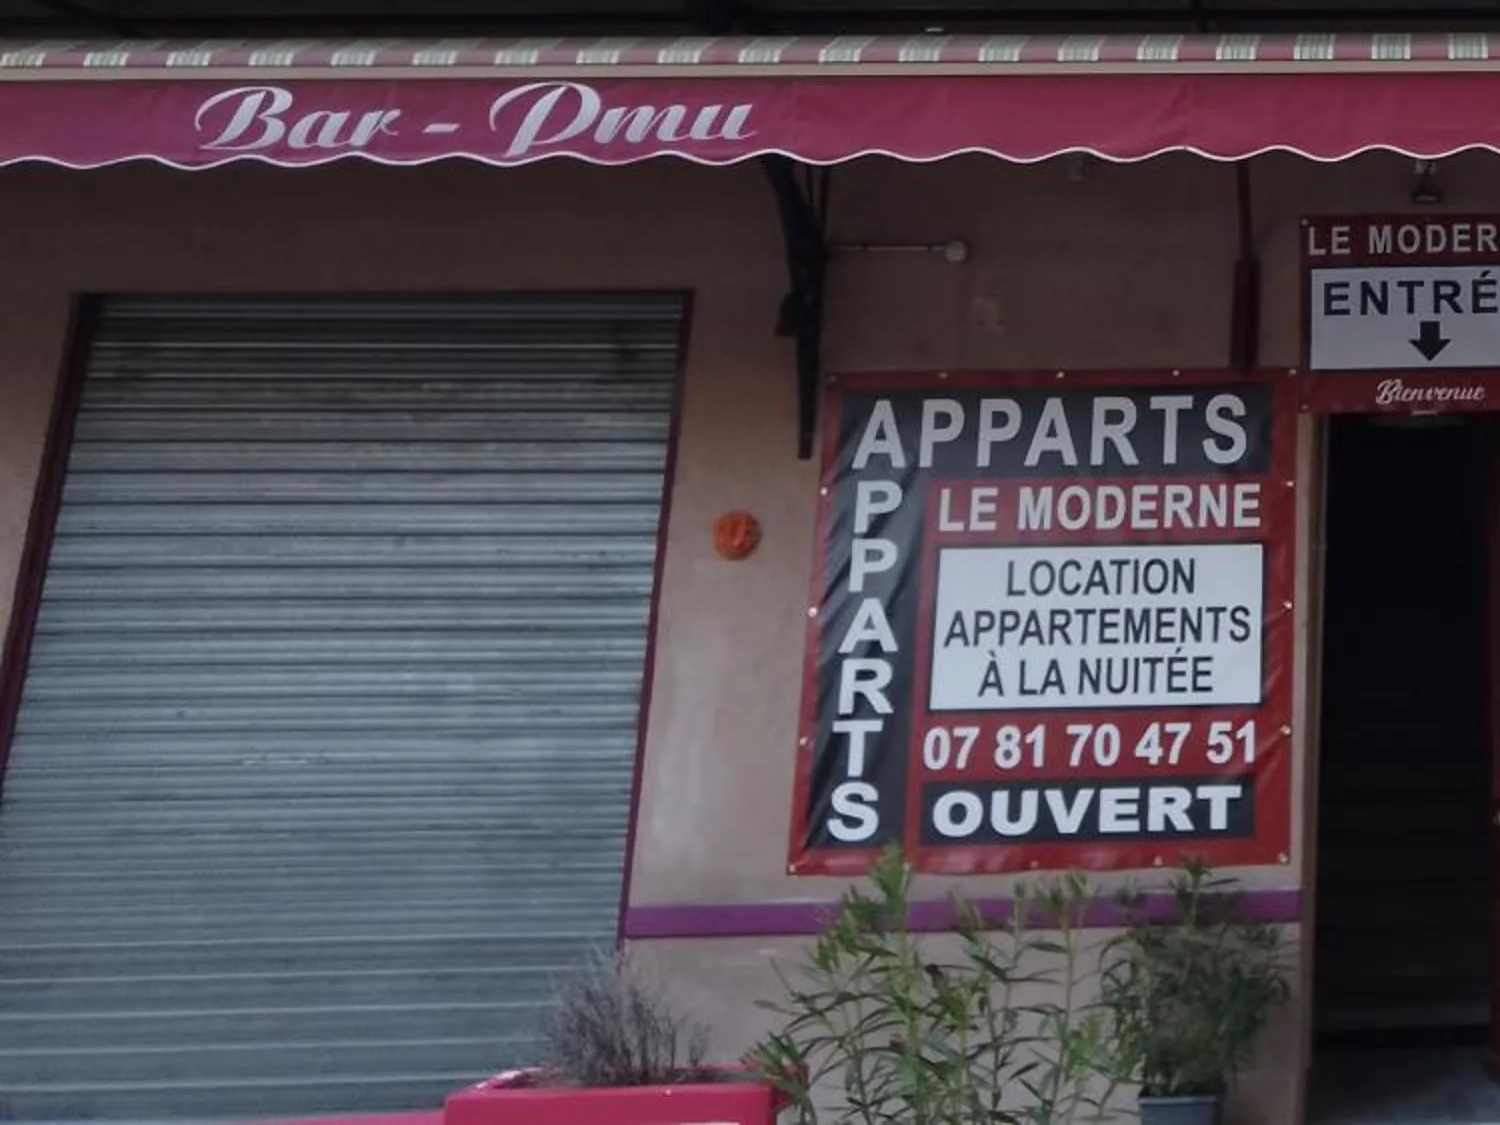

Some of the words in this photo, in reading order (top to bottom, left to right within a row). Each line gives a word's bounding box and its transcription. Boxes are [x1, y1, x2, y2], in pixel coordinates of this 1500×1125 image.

[195, 86, 402, 150] Bar
[1307, 226, 1351, 256] LE
[1375, 378, 1486, 405] Bienvenue
[852, 394, 1249, 470] APPARTS
[938, 486, 999, 532] LE
[1017, 483, 1261, 530] MODERNE
[1006, 558, 1196, 596] LOCATION
[944, 606, 1251, 647] APPARTEMENTS
[977, 650, 1005, 697] À
[1018, 658, 1066, 696] LA
[1078, 647, 1214, 694] NUITÉE
[923, 727, 981, 770] 07
[994, 724, 1046, 768] 81
[1066, 723, 1121, 767] 70
[1135, 721, 1192, 765] 47
[1206, 720, 1257, 764] 51
[932, 785, 1243, 837] OUVERT
